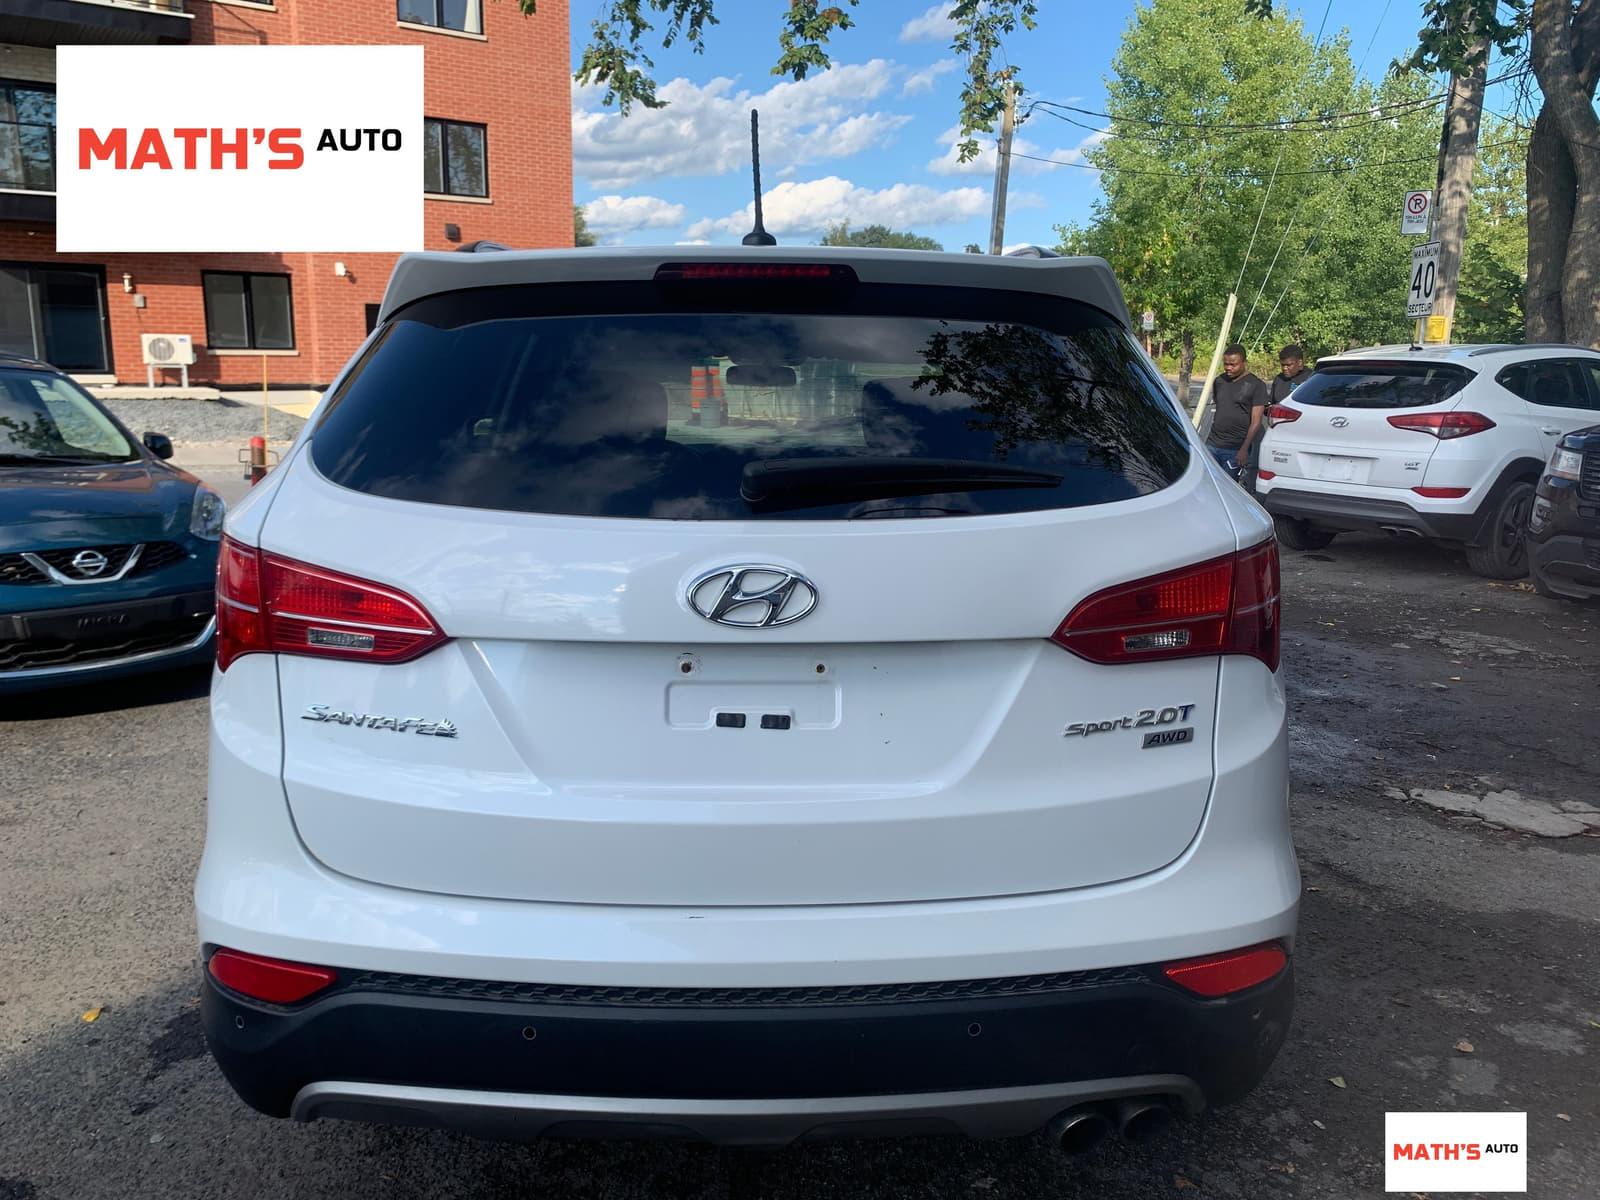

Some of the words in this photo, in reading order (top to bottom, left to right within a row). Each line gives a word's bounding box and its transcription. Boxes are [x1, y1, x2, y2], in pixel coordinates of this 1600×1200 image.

[1411, 260, 1435, 299] 40
[1408, 302, 1432, 313] SECTEUR
[1062, 716, 1133, 738] Sport
[1147, 729, 1188, 745] AWD
